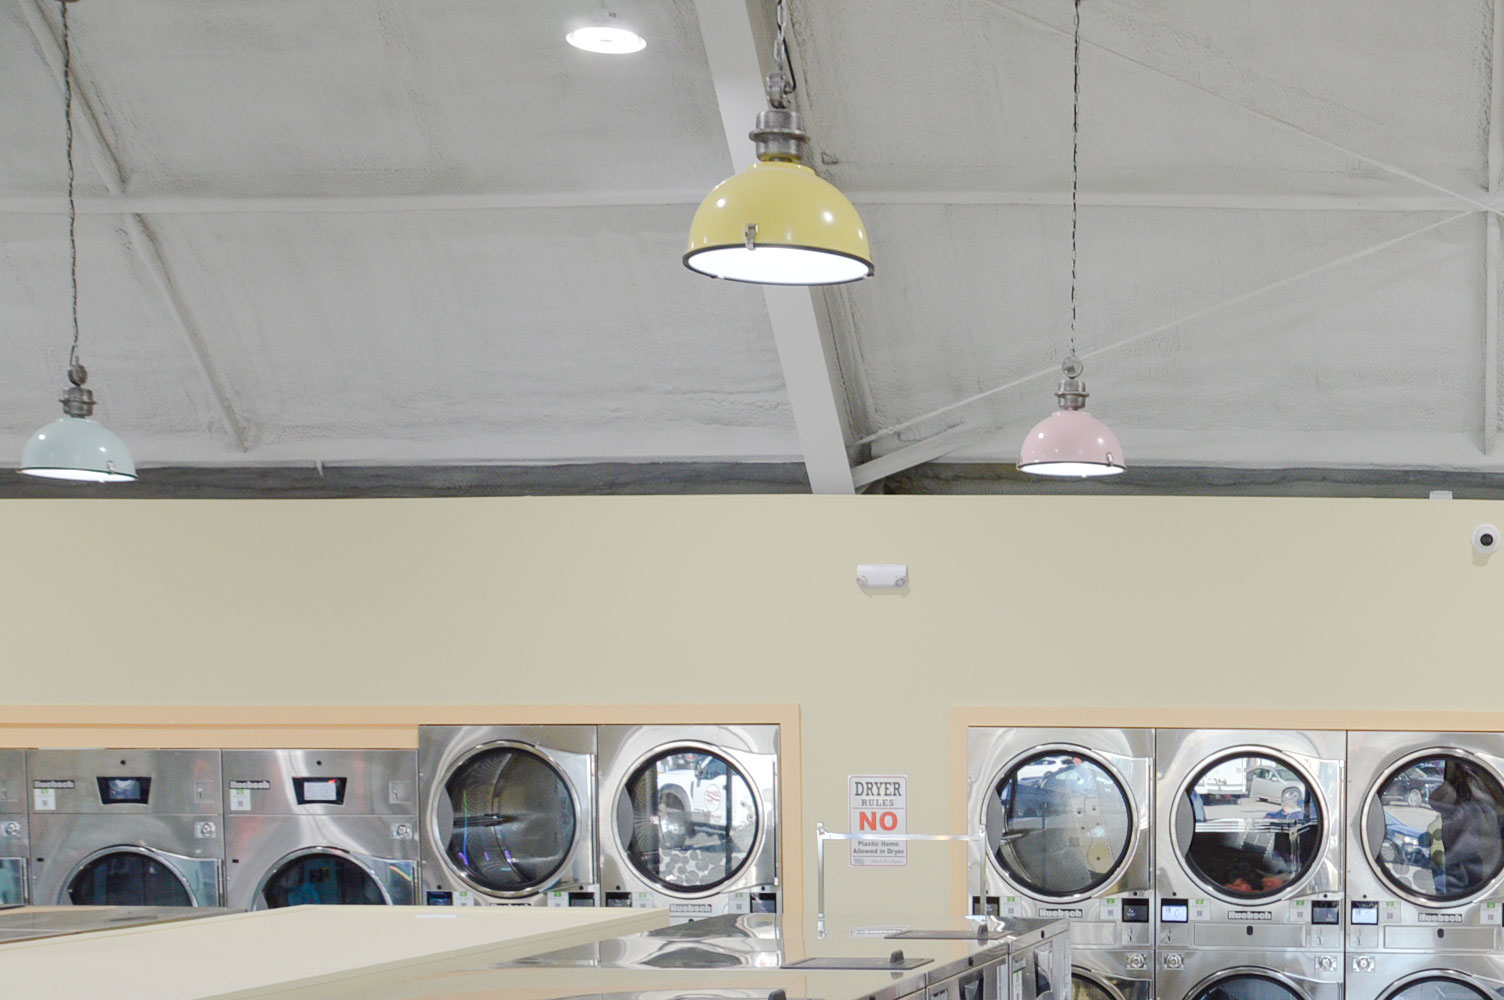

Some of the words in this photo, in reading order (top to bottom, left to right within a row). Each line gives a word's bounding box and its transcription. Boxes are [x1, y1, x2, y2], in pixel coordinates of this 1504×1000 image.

[855, 782, 902, 797] DRYER
[861, 799, 894, 807] RULES
[859, 811, 898, 831] NO
[887, 848, 904, 856] Dryer
